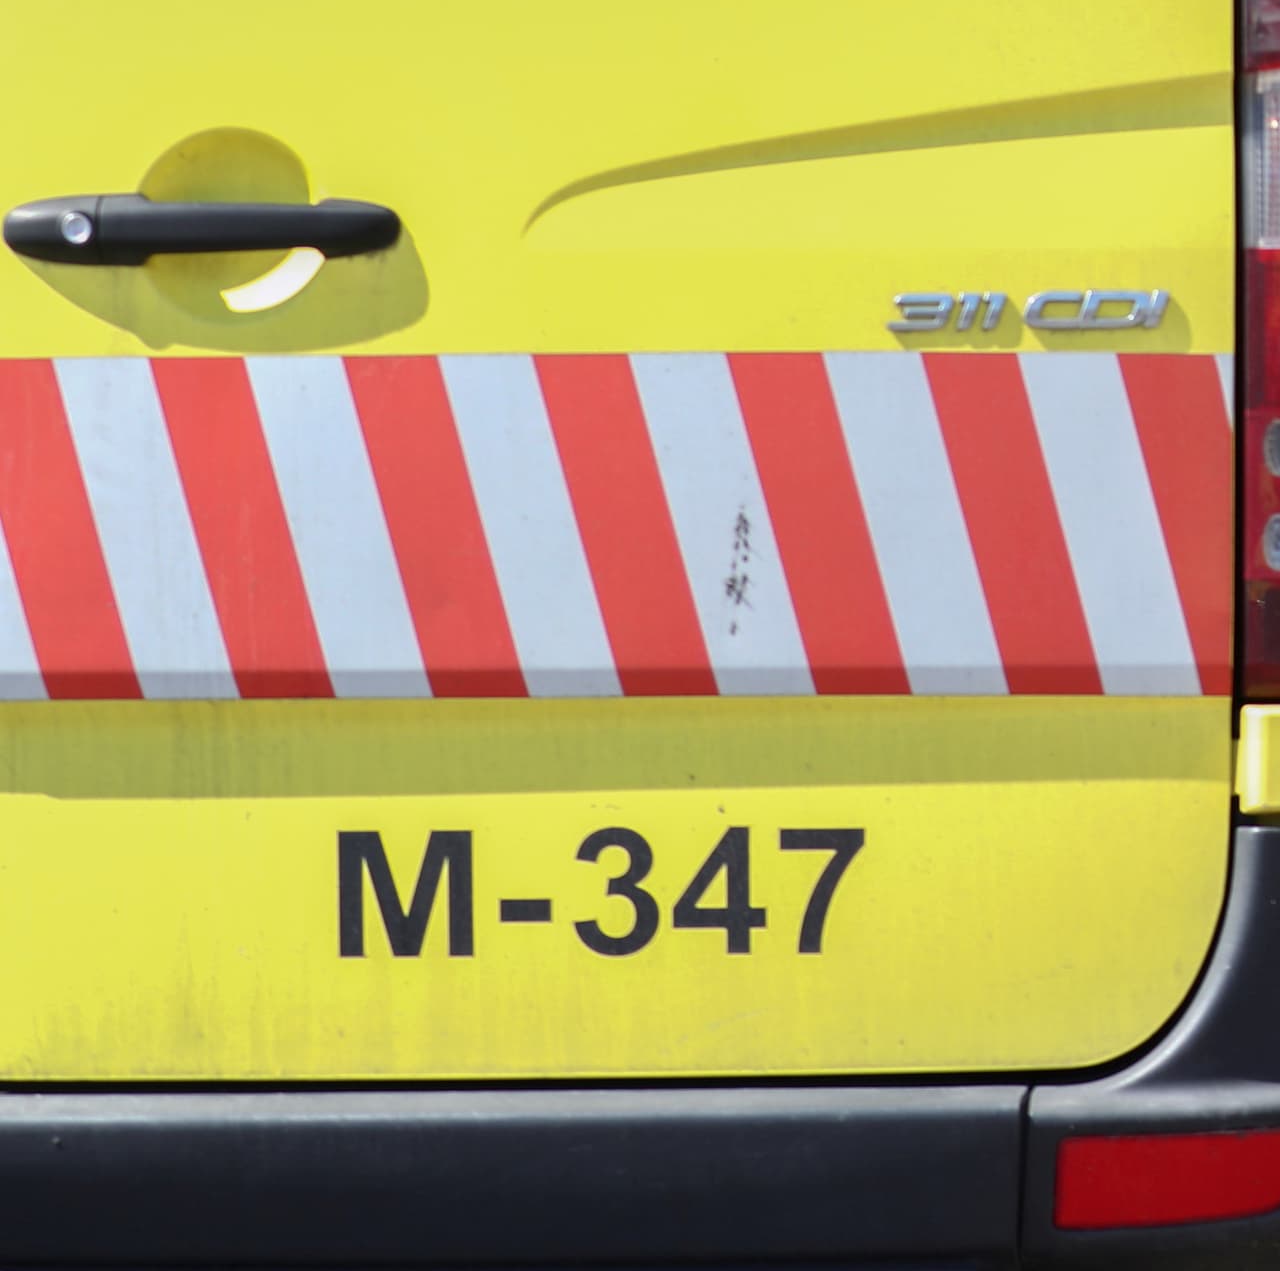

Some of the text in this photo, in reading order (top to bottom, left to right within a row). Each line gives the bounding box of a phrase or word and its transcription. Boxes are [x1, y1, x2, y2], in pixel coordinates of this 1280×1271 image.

[887, 288, 1171, 332] 311 CDI
[336, 825, 867, 958] M-347
